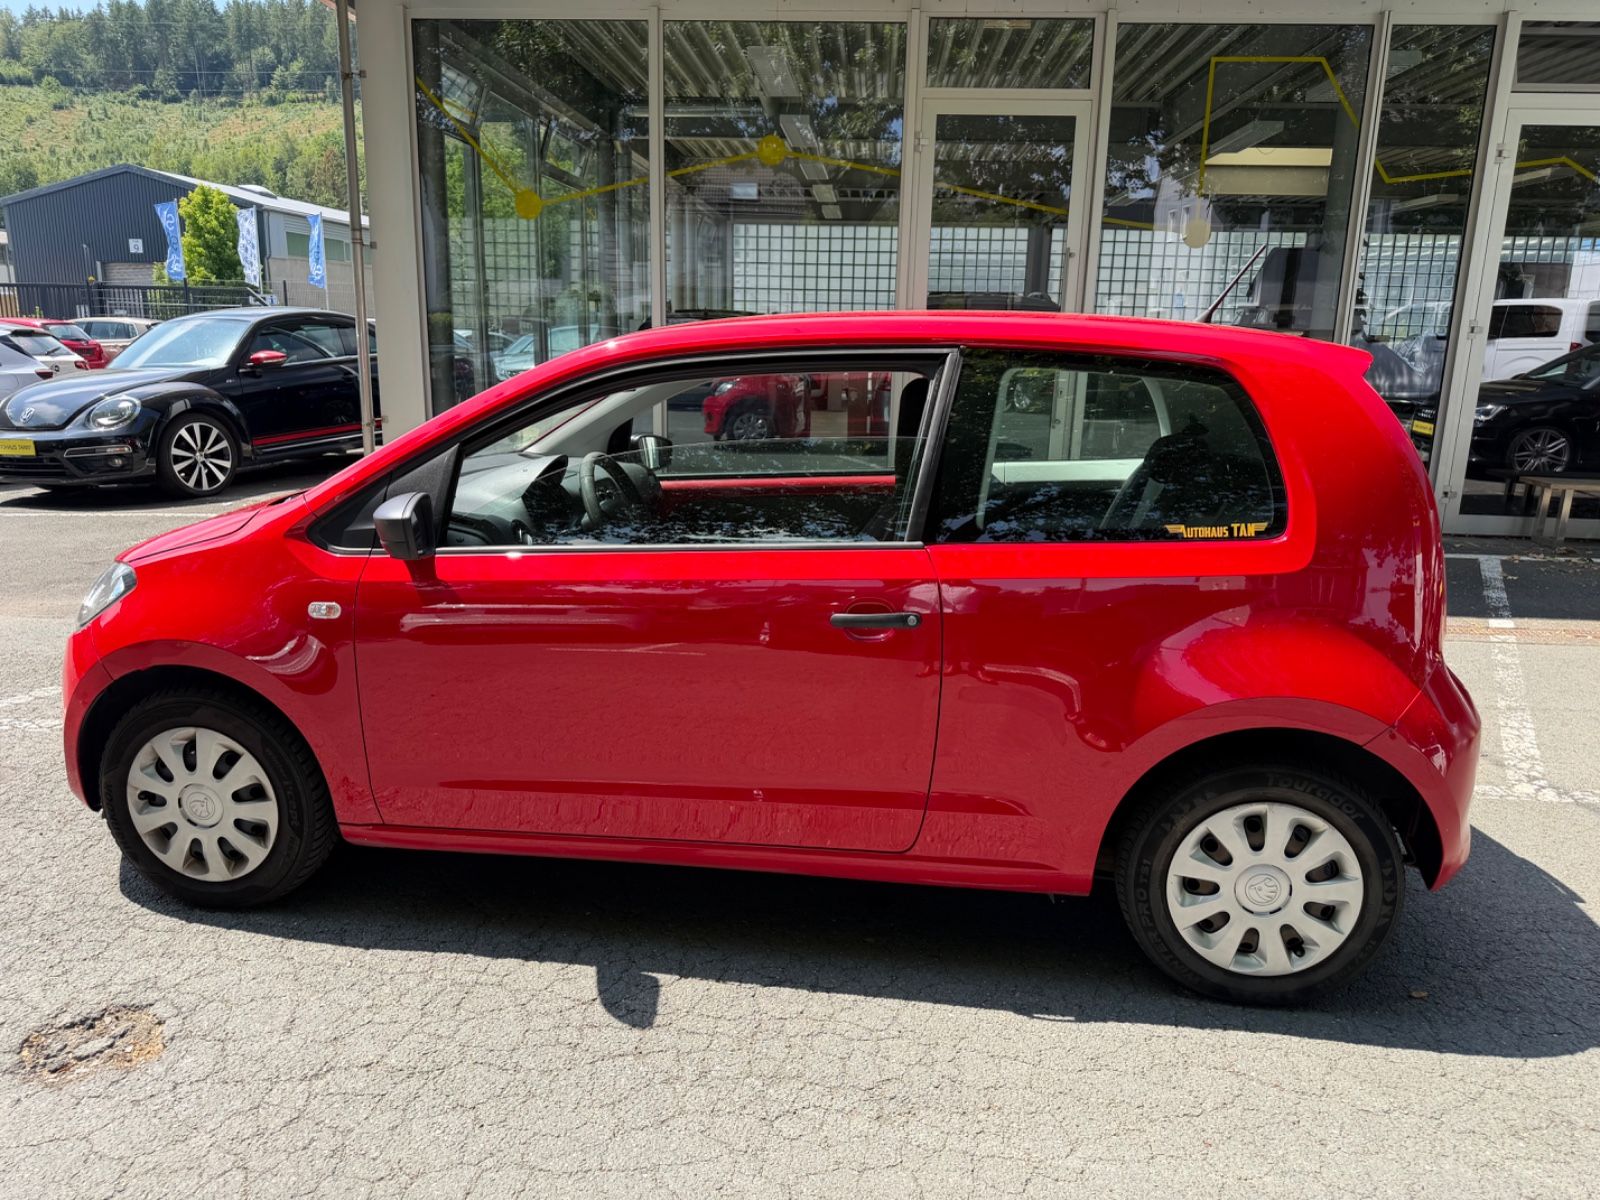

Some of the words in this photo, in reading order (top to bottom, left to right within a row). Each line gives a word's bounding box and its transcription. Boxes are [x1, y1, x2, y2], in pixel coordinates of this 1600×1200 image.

[1181, 524, 1229, 538] AUTOHAUS
[1265, 773, 1367, 822] Tourador
[1136, 888, 1156, 930] PRO
